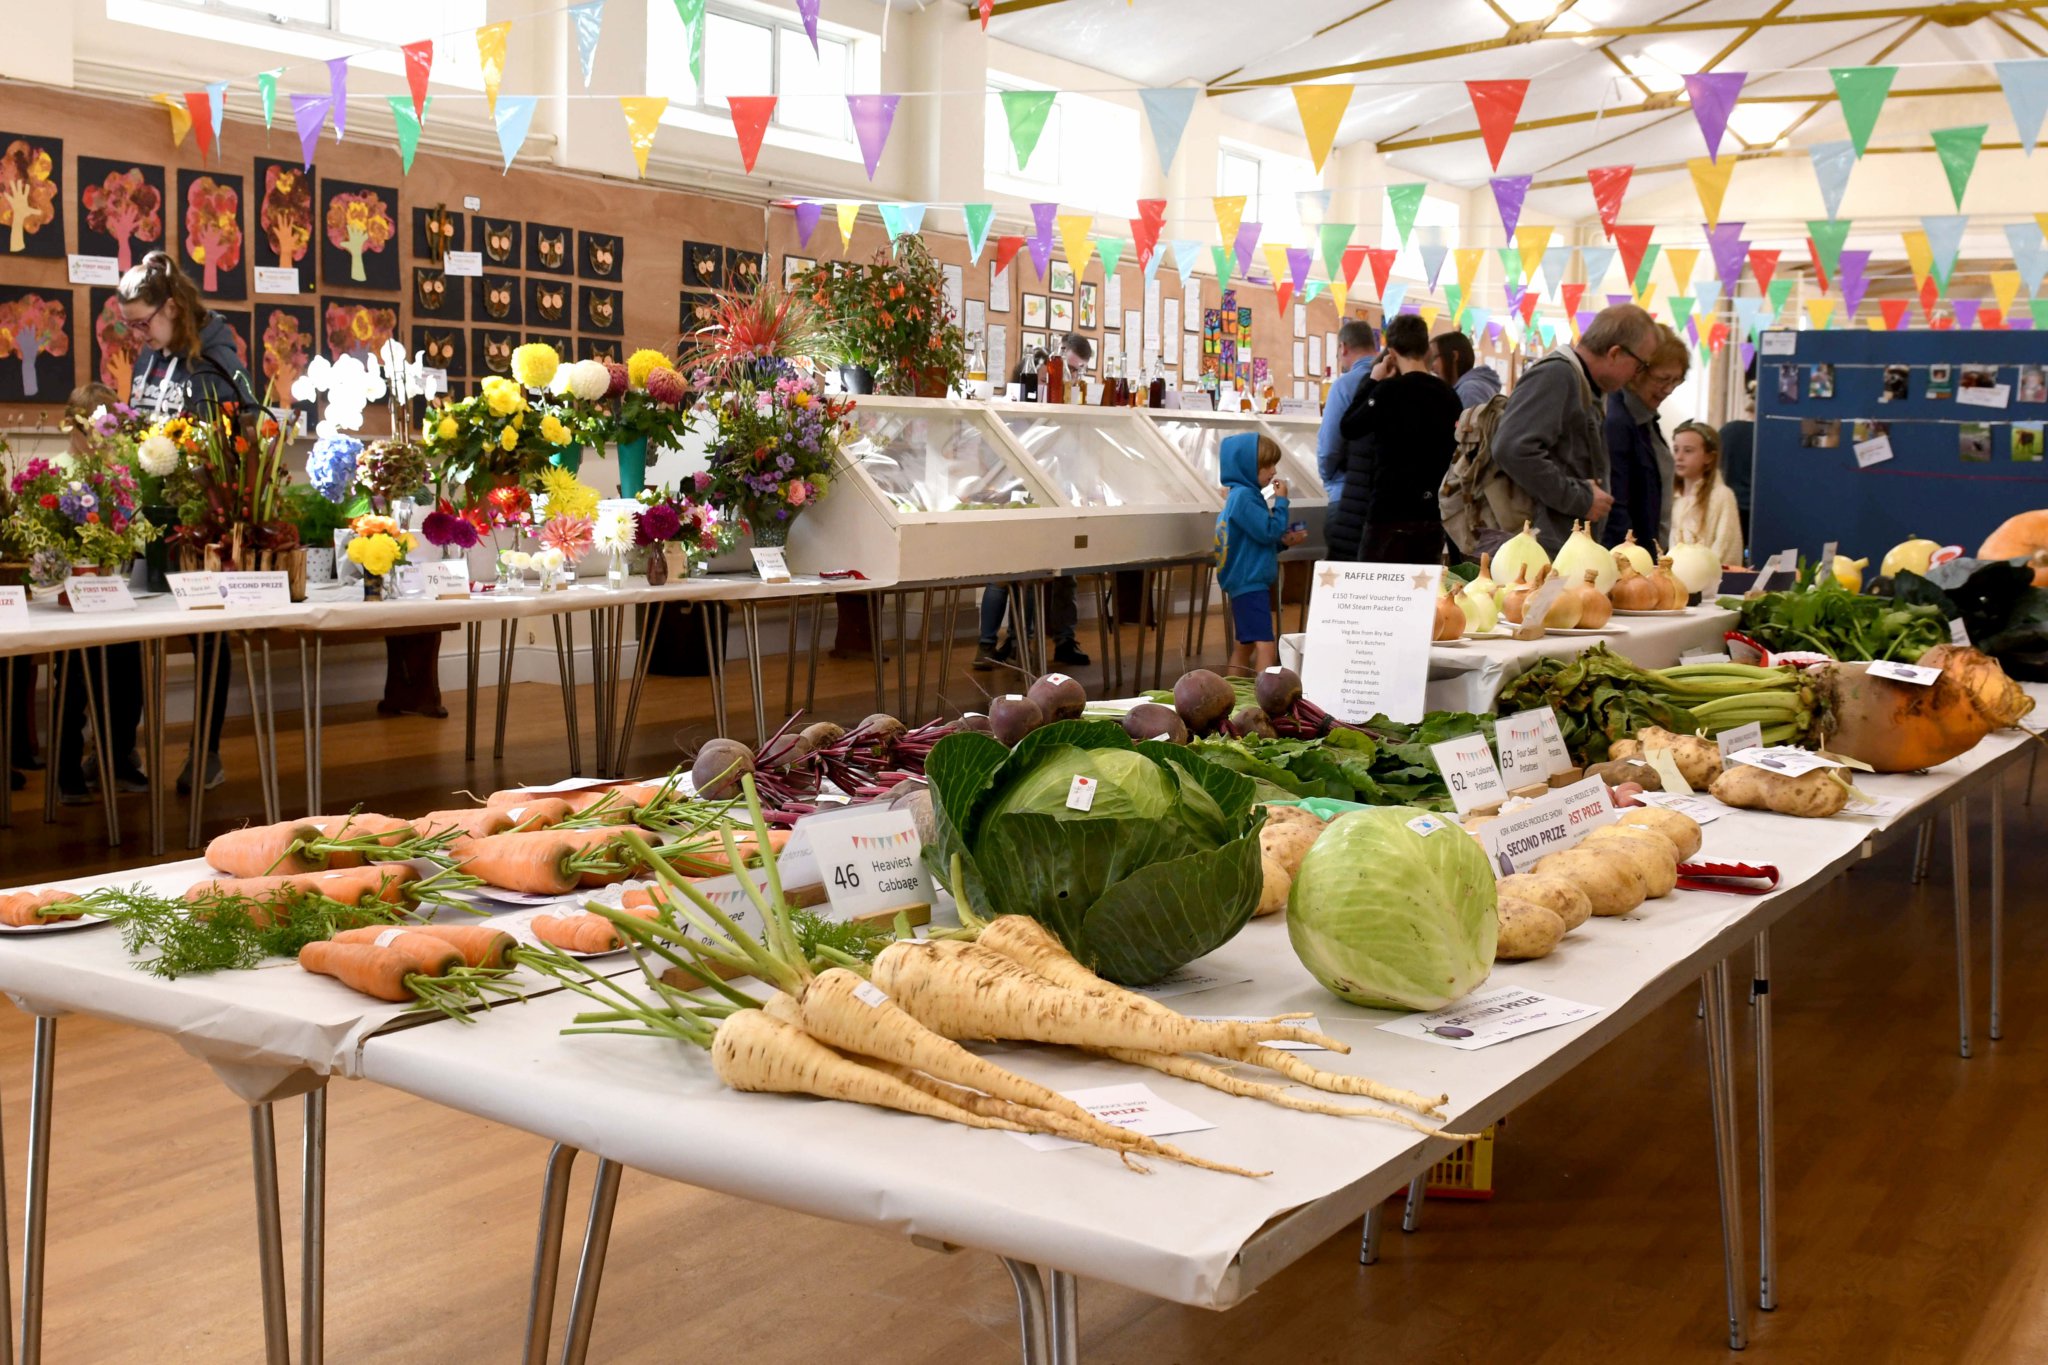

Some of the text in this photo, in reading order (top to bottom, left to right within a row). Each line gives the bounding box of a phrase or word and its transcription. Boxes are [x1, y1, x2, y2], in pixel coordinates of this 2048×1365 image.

[427, 575, 439, 585] 76
[1344, 571, 1405, 582] RAFFLE PRIZES
[174, 588, 187, 597] 81
[1352, 603, 1372, 611] Steam
[1373, 604, 1394, 612] Packet
[1527, 745, 1538, 756] Seed
[1502, 750, 1514, 769] 63
[1519, 762, 1539, 773] Potatoes
[1465, 769, 1476, 778] Four
[1450, 772, 1468, 792] 62
[1474, 780, 1497, 791] Potatoes
[1590, 786, 1600, 797] SHOW
[1582, 801, 1604, 820] PRIZE
[1510, 819, 1529, 833] ANDREAS
[1529, 811, 1549, 826] PRODUCE
[1549, 808, 1563, 821] SHOW
[1506, 834, 1540, 857] SECOND
[1540, 824, 1567, 845] PRIZE
[872, 856, 913, 872] Heaviest
[834, 863, 860, 890] 46
[878, 877, 919, 893] Cabbage
[1499, 995, 1546, 1010] PRIZE
[1099, 1107, 1150, 1116] PRIZE
